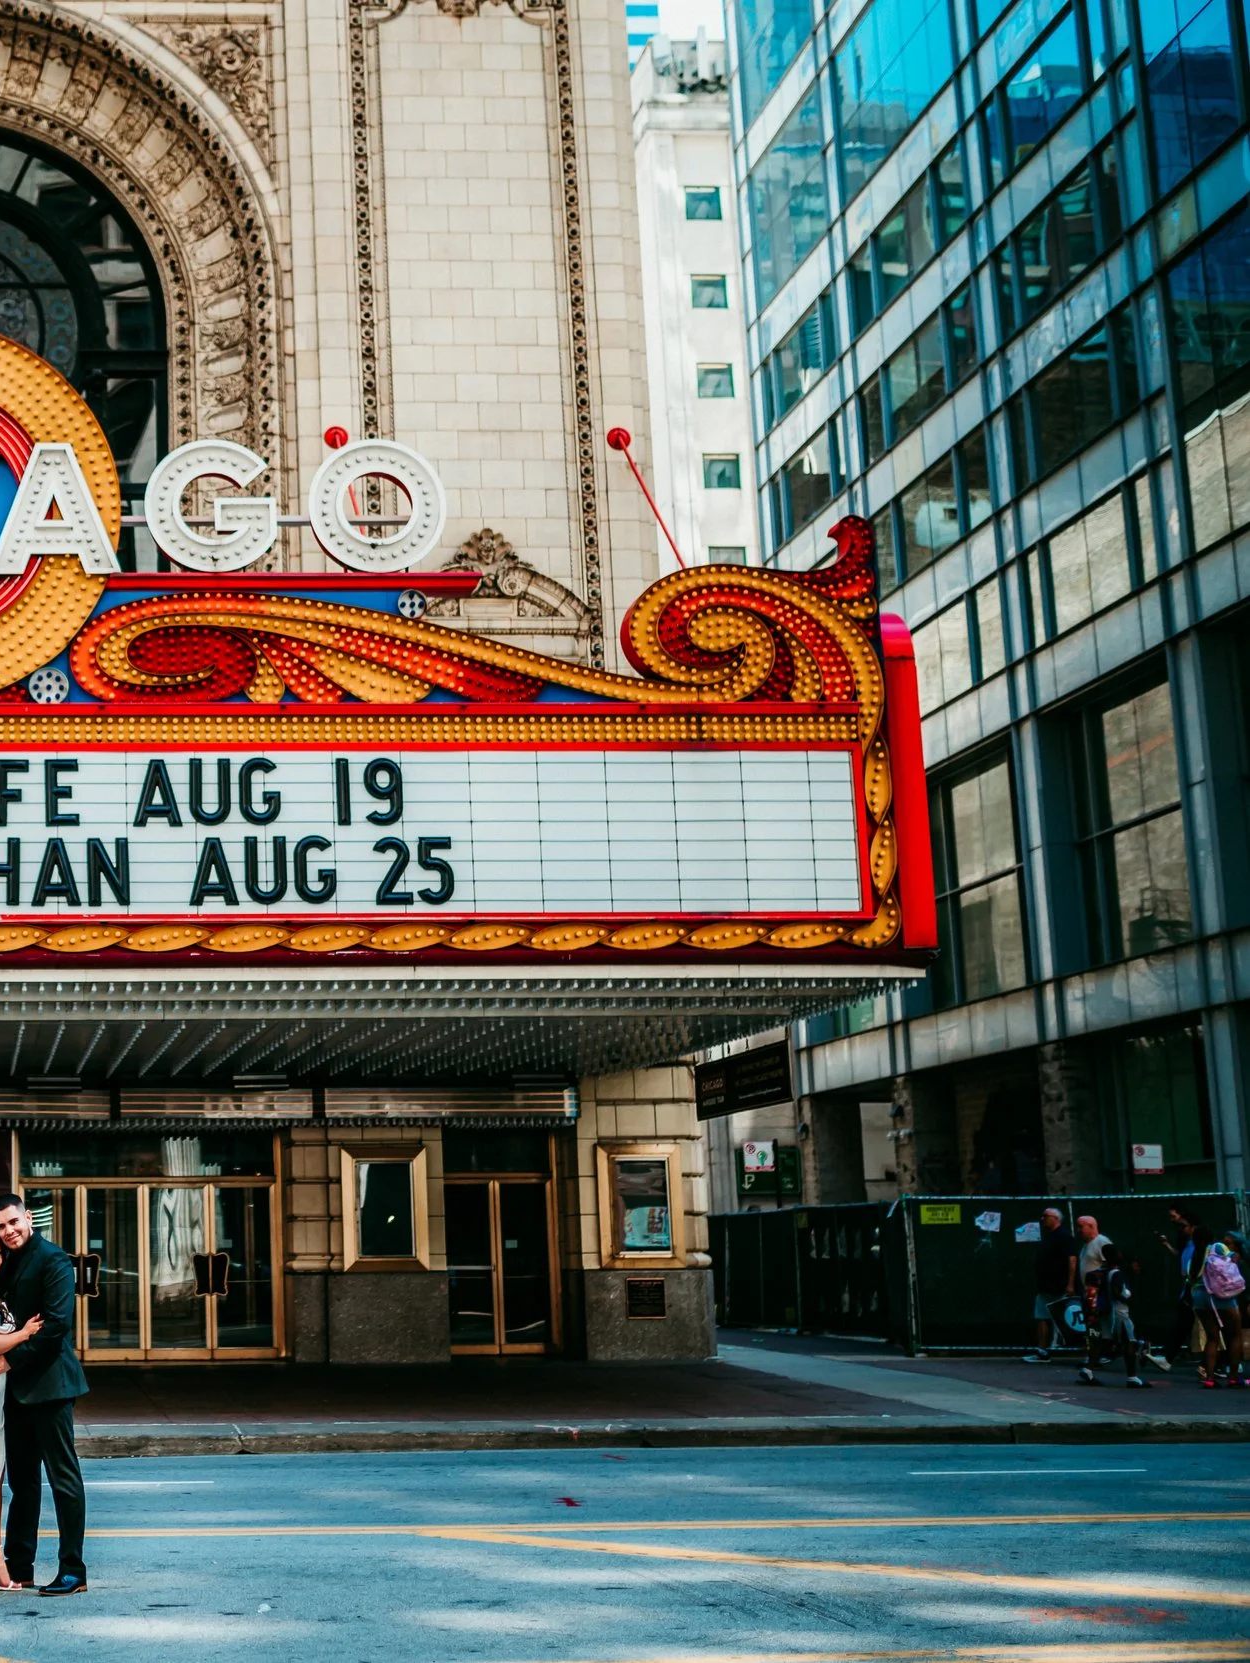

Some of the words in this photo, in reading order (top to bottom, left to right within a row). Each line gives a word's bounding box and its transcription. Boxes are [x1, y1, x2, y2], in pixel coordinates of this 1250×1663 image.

[133, 757, 282, 827] AUG
[335, 757, 404, 827] 19
[189, 834, 338, 907] AUG
[372, 836, 455, 907] 25
